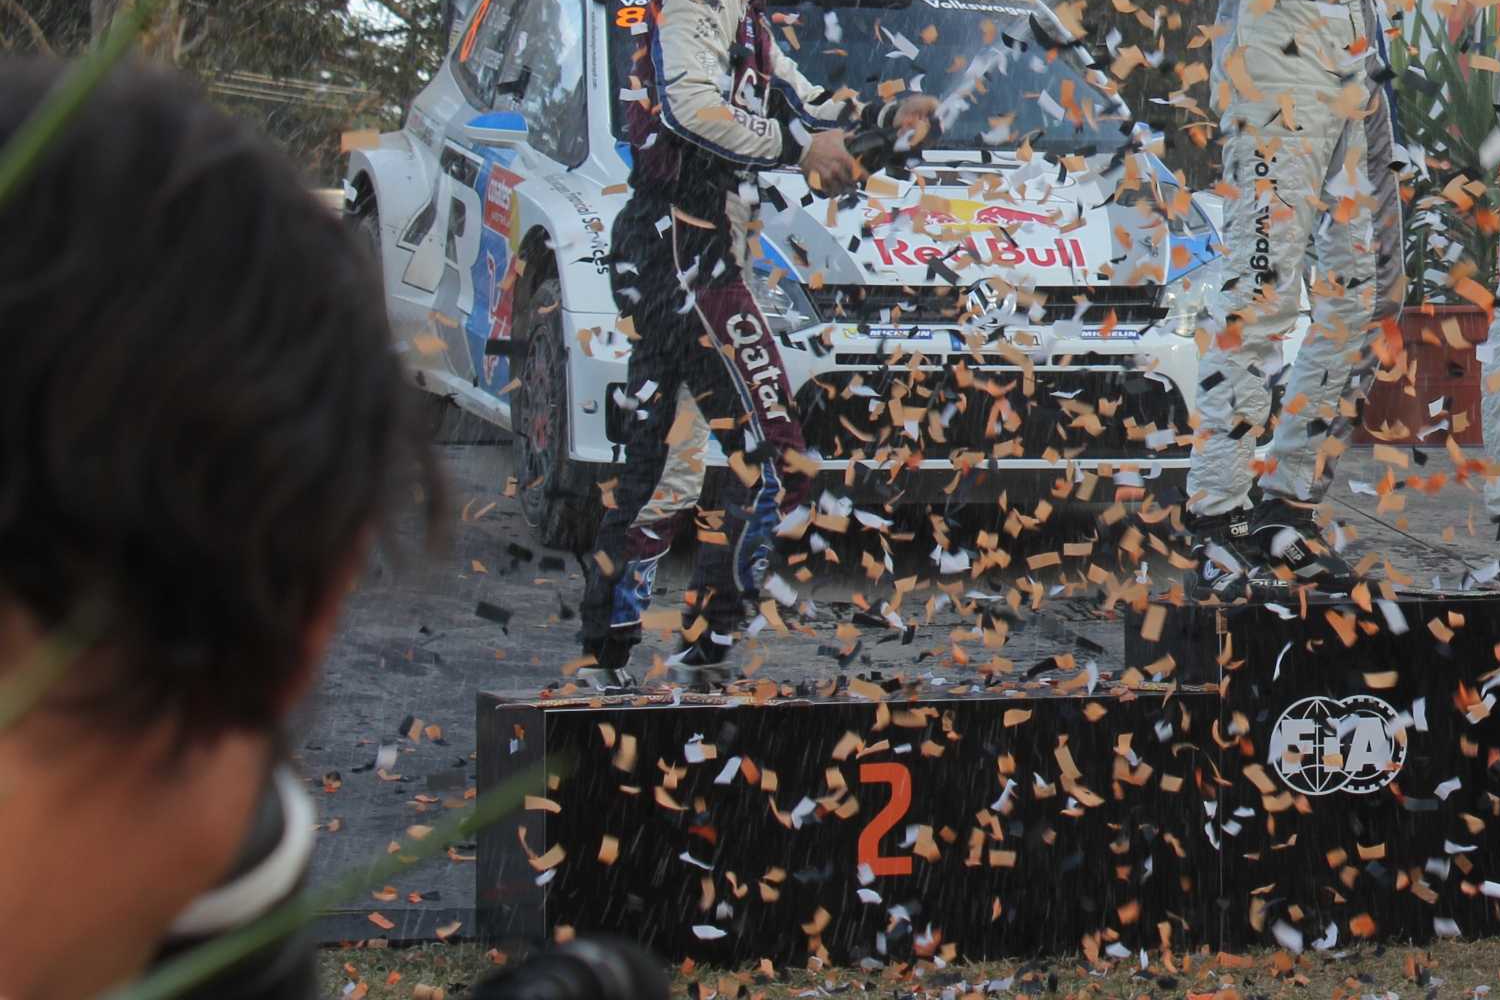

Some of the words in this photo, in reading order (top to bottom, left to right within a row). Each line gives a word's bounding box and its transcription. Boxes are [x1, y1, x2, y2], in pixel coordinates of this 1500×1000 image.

[615, 6, 646, 29] 8
[873, 236, 981, 267] Red
[985, 236, 1086, 267] Bull
[726, 312, 792, 424] Qatar
[1281, 717, 1393, 774] FIA
[857, 762, 913, 875] 2
